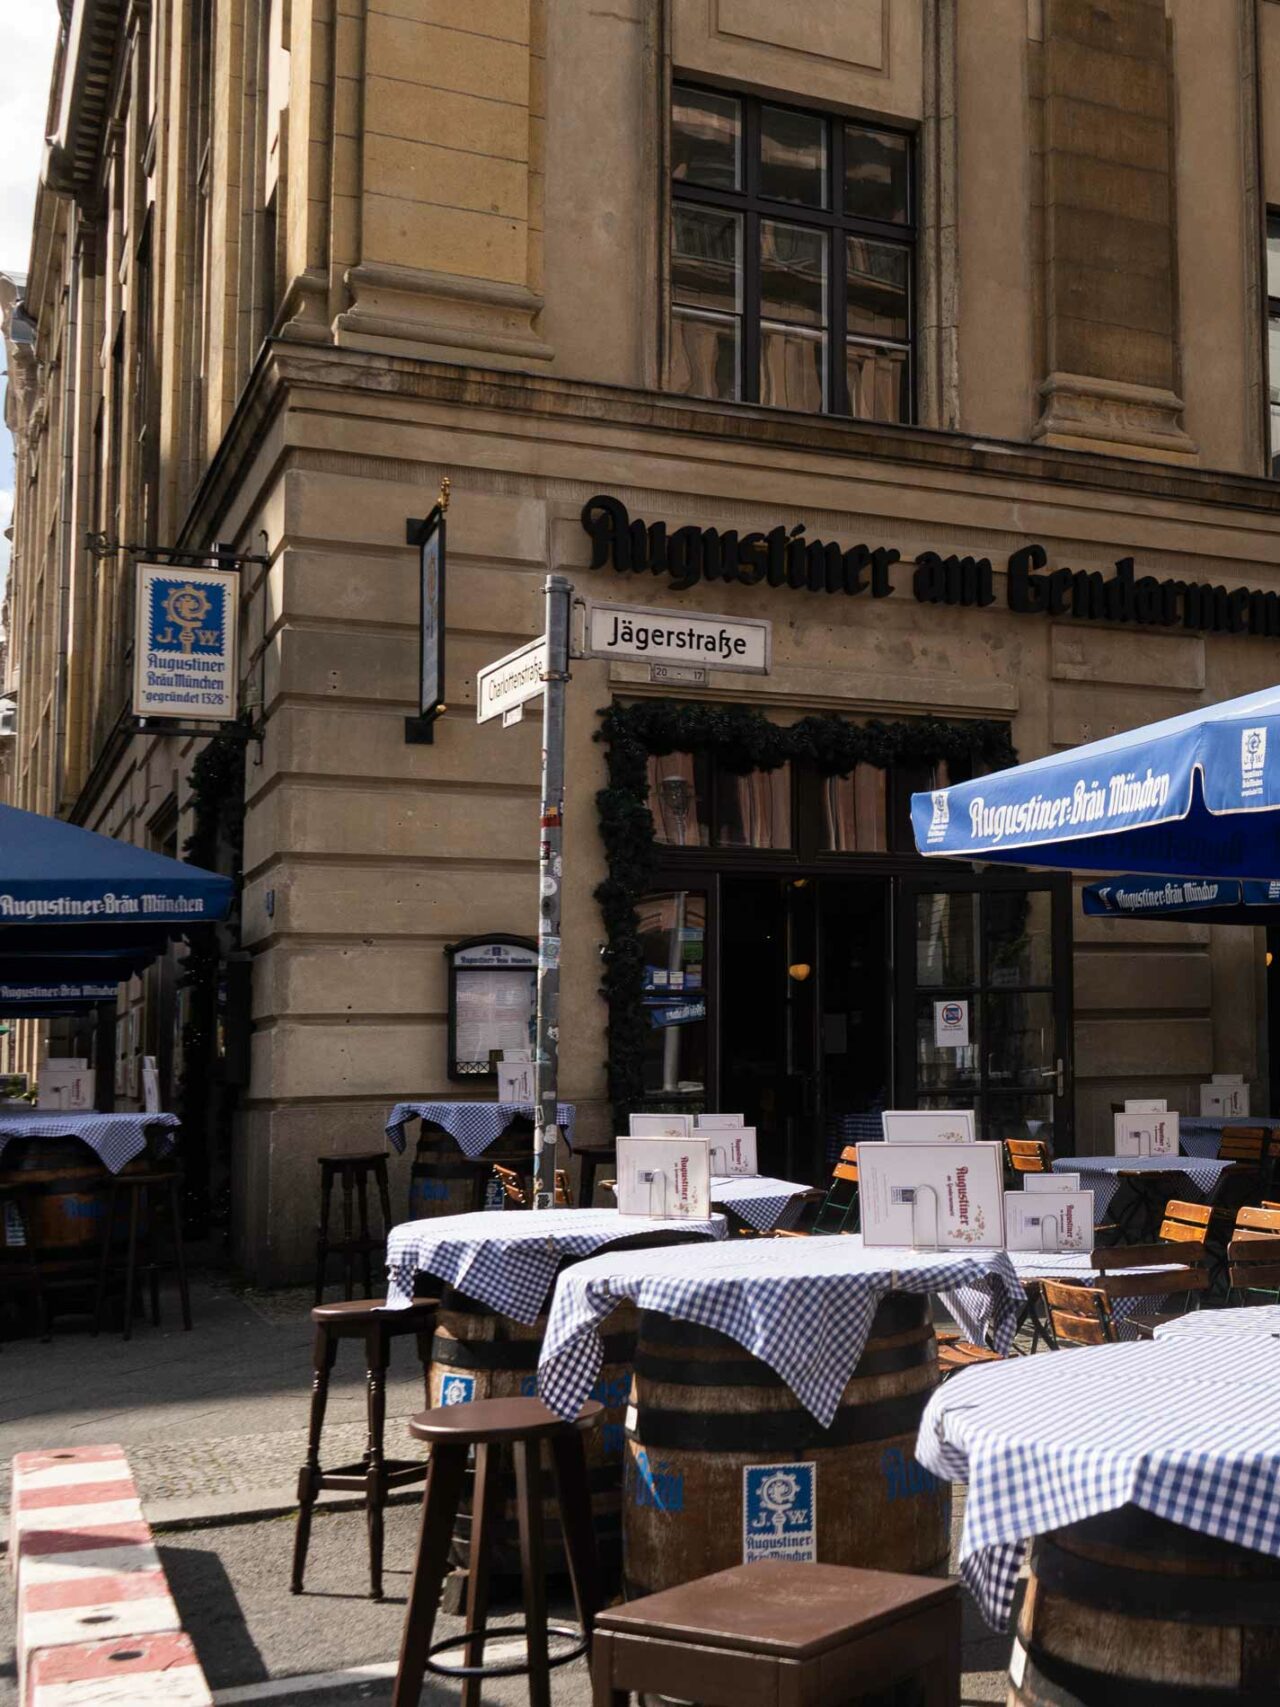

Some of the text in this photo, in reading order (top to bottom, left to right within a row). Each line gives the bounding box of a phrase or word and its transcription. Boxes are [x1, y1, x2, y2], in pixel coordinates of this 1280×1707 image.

[581, 495, 901, 598] Augustiner
[914, 552, 998, 606] am
[607, 617, 746, 666] Jägerstraße
[147, 671, 225, 691] Bräu München
[656, 667, 668, 677] 20
[693, 671, 703, 680] 17
[146, 691, 200, 706] gegründet
[1108, 767, 1170, 818] München
[140, 893, 205, 913] München
[679, 1155, 690, 1201] Augustiner
[955, 1165, 969, 1226] Augustiner
[1065, 1204, 1075, 1238] Augustiner
